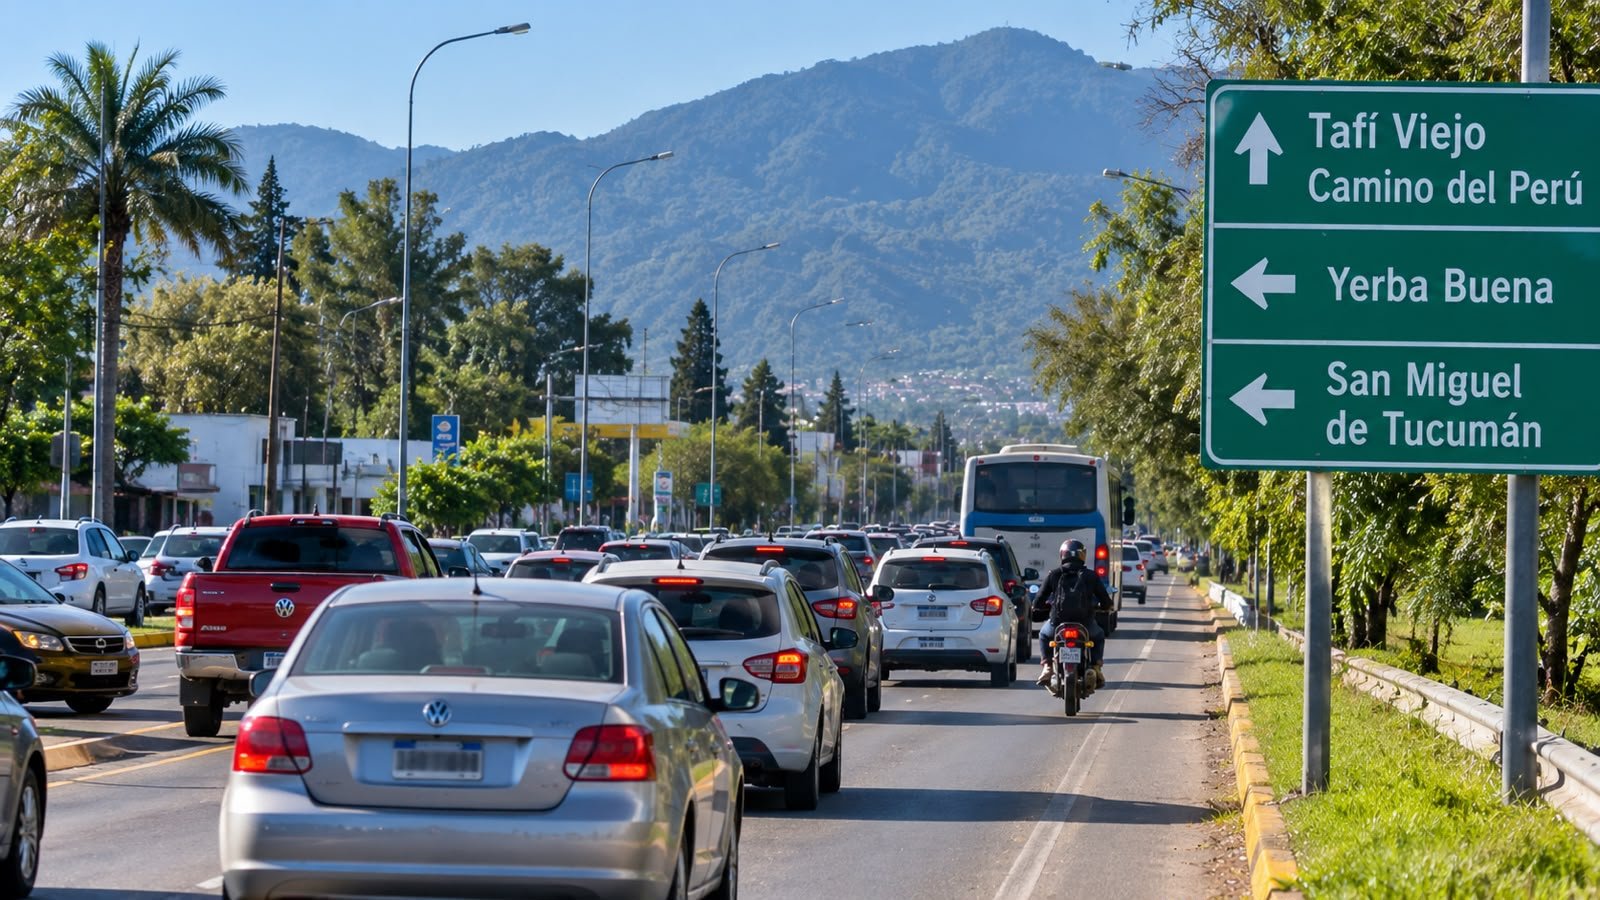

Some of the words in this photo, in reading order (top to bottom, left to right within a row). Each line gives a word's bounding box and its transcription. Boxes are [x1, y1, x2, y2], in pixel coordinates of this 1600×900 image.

[1308, 111, 1378, 149] Tafí
[1392, 112, 1486, 159] Viejo
[1308, 167, 1434, 204] Camino
[1447, 169, 1496, 204] del
[1510, 170, 1583, 206] Perú
[1327, 266, 1428, 303] Yerba
[1444, 267, 1554, 304] Buena
[1326, 360, 1391, 396] San
[1407, 361, 1522, 406] Miguel
[1326, 409, 1368, 446] de
[1382, 410, 1542, 448] Tucumán
